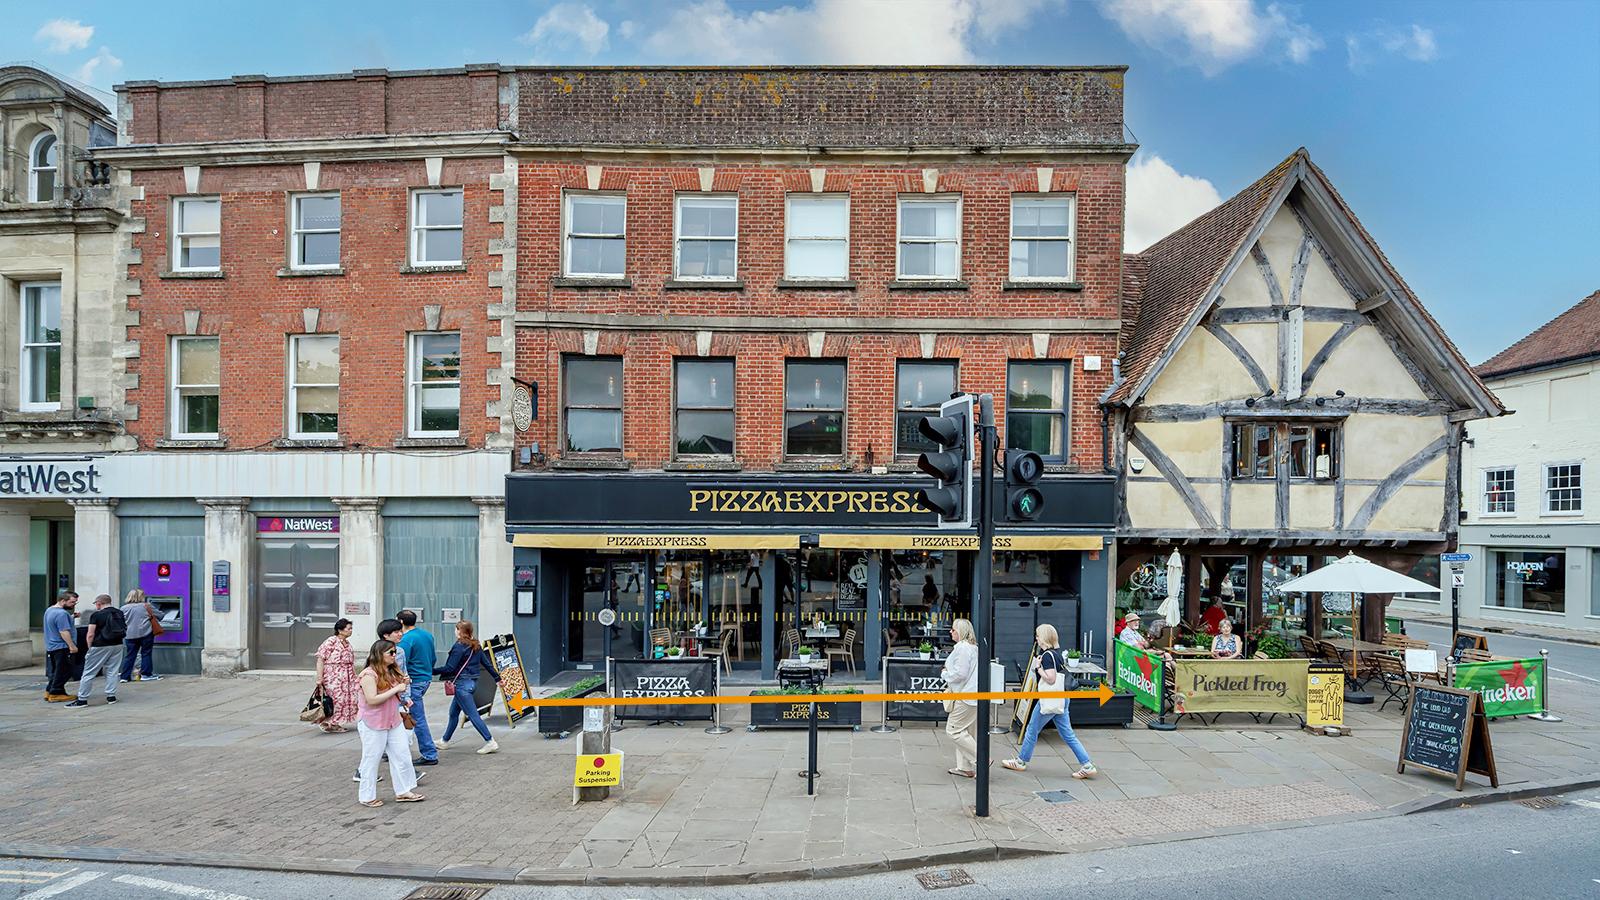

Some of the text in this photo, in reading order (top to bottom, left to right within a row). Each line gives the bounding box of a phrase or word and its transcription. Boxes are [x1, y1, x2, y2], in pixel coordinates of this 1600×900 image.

[690, 490, 932, 513] PIZZAEXPRESS
[284, 519, 332, 530] NatWest
[606, 537, 707, 546] PIZZAEXPRESS
[912, 537, 1012, 547] PIZZAEXPSS
[636, 676, 690, 690] PIZZA
[910, 676, 948, 690] PIZZ
[1118, 659, 1157, 697] Heineken
[1193, 674, 1289, 698] Pickled Frog
[1460, 684, 1537, 703] ineken
[782, 711, 830, 719] EXPRSS
